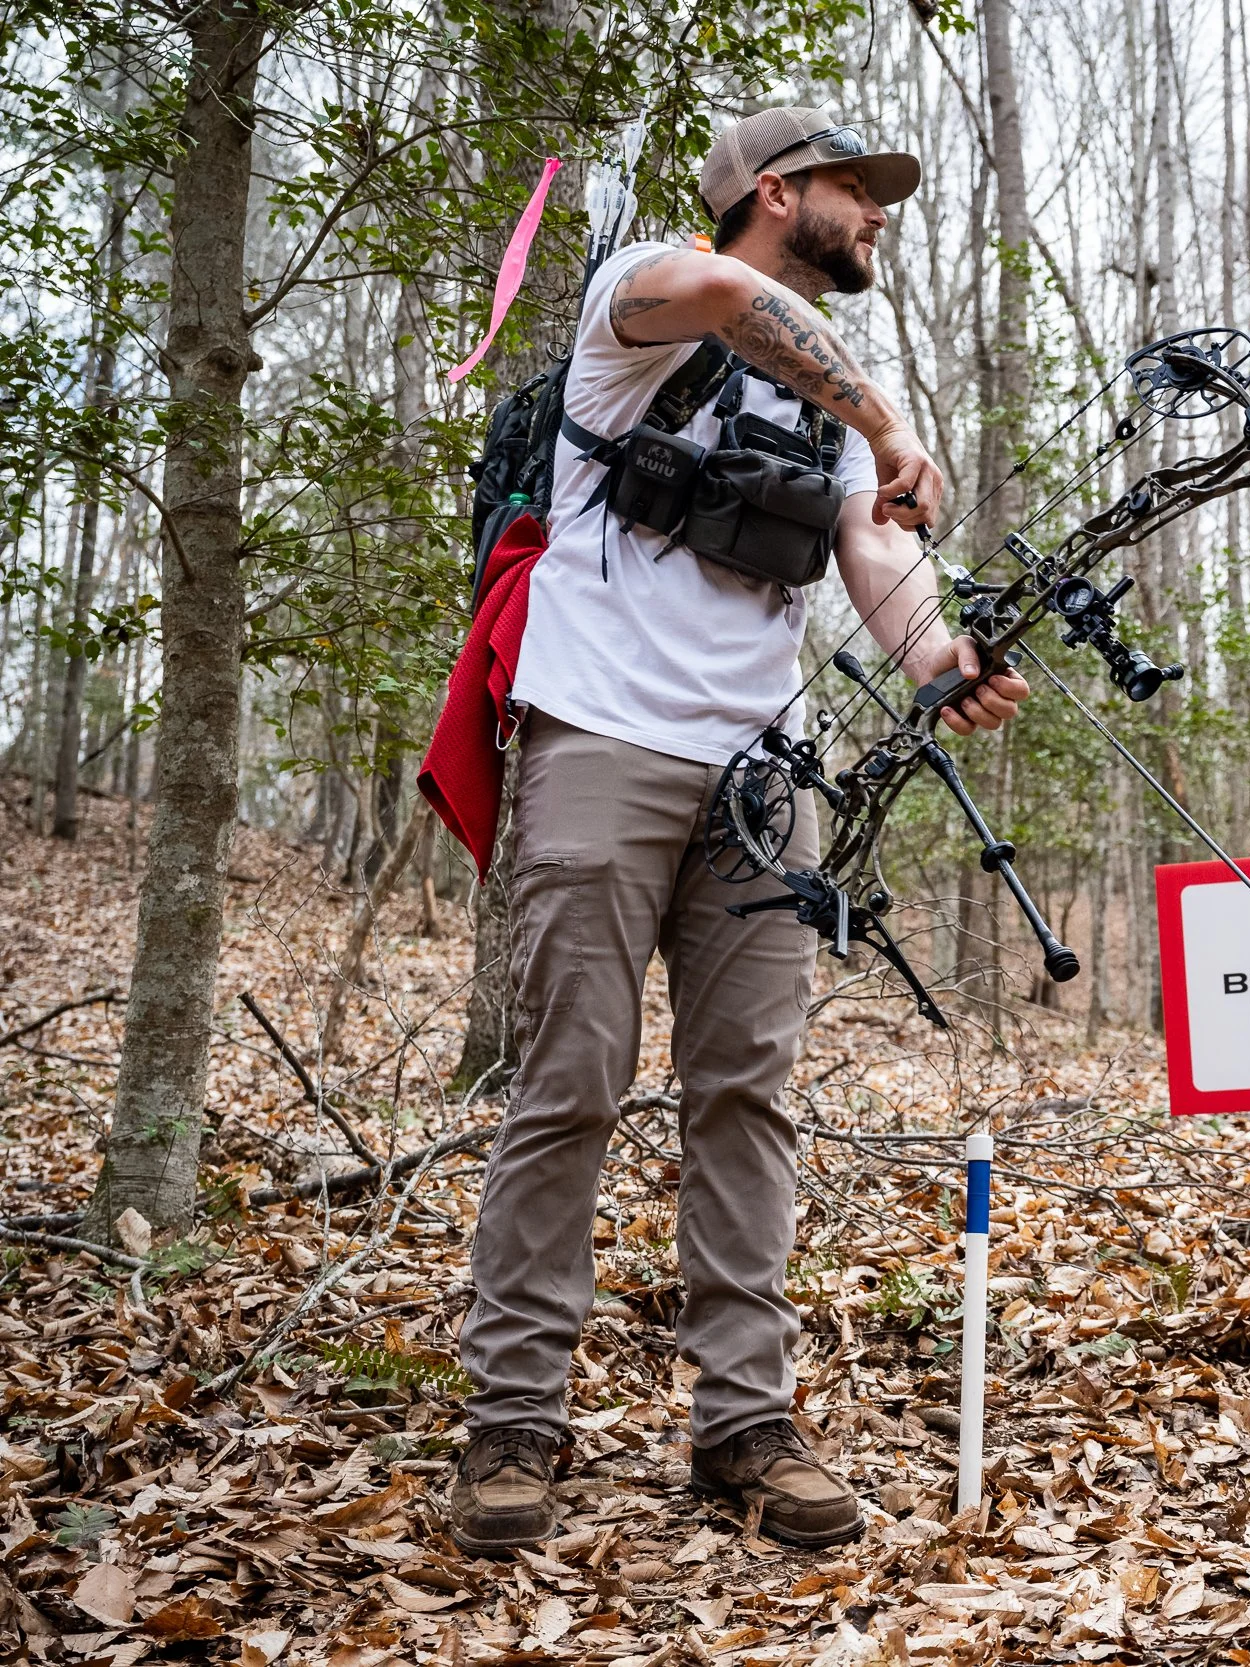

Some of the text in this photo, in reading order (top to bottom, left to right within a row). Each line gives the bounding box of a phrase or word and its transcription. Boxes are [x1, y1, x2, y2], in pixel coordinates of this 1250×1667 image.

[752, 288, 864, 408] Three One Eight
[636, 455, 677, 478] KUIU
